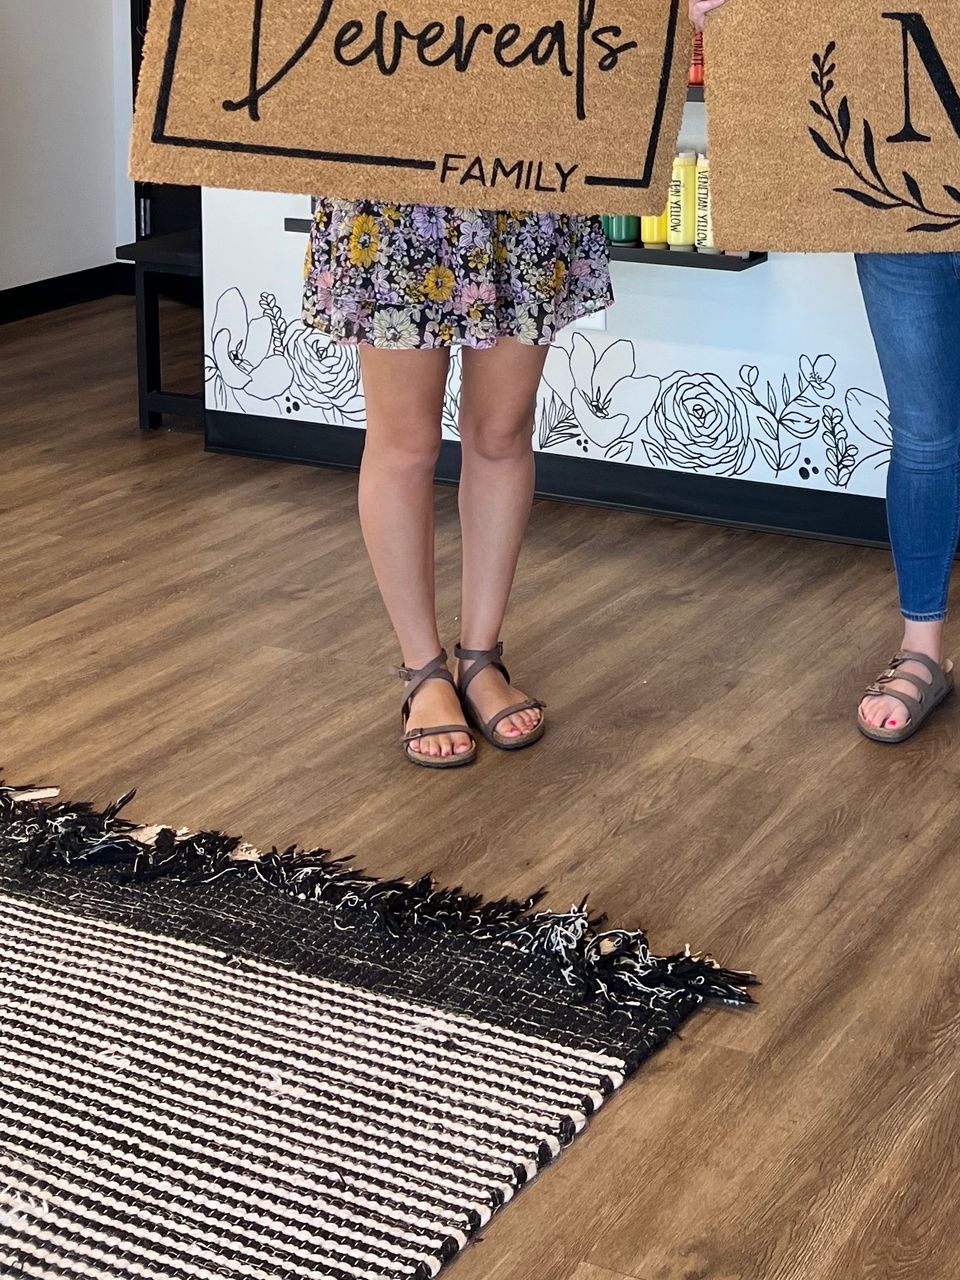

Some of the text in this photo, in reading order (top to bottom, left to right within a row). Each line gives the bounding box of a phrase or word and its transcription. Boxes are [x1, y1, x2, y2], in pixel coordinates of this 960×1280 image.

[440, 153, 580, 194] FAMILY
[670, 199, 682, 233] YELLOW
[696, 171, 709, 247] VENETIAN YELLOW
